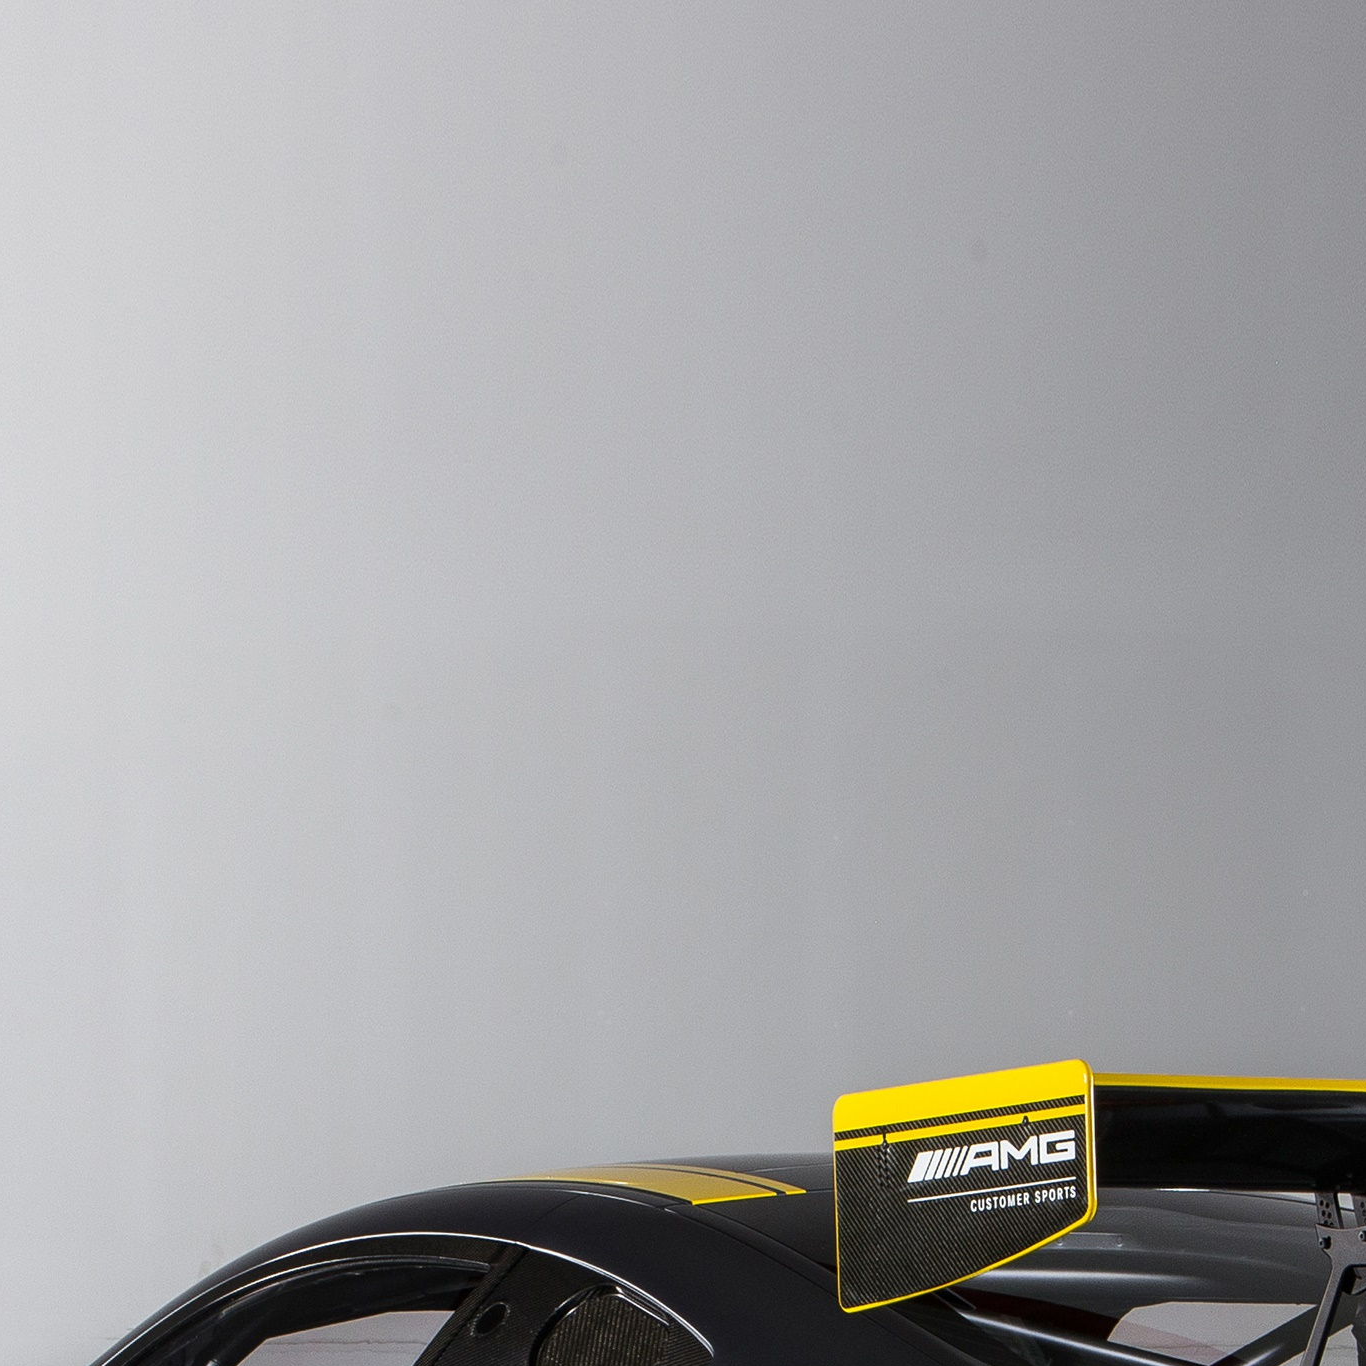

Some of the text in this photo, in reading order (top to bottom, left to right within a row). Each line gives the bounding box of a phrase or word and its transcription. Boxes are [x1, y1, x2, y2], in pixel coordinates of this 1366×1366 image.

[959, 1129, 1076, 1176] AMG
[969, 1185, 1077, 1213] CUSTOMER SPORTS
